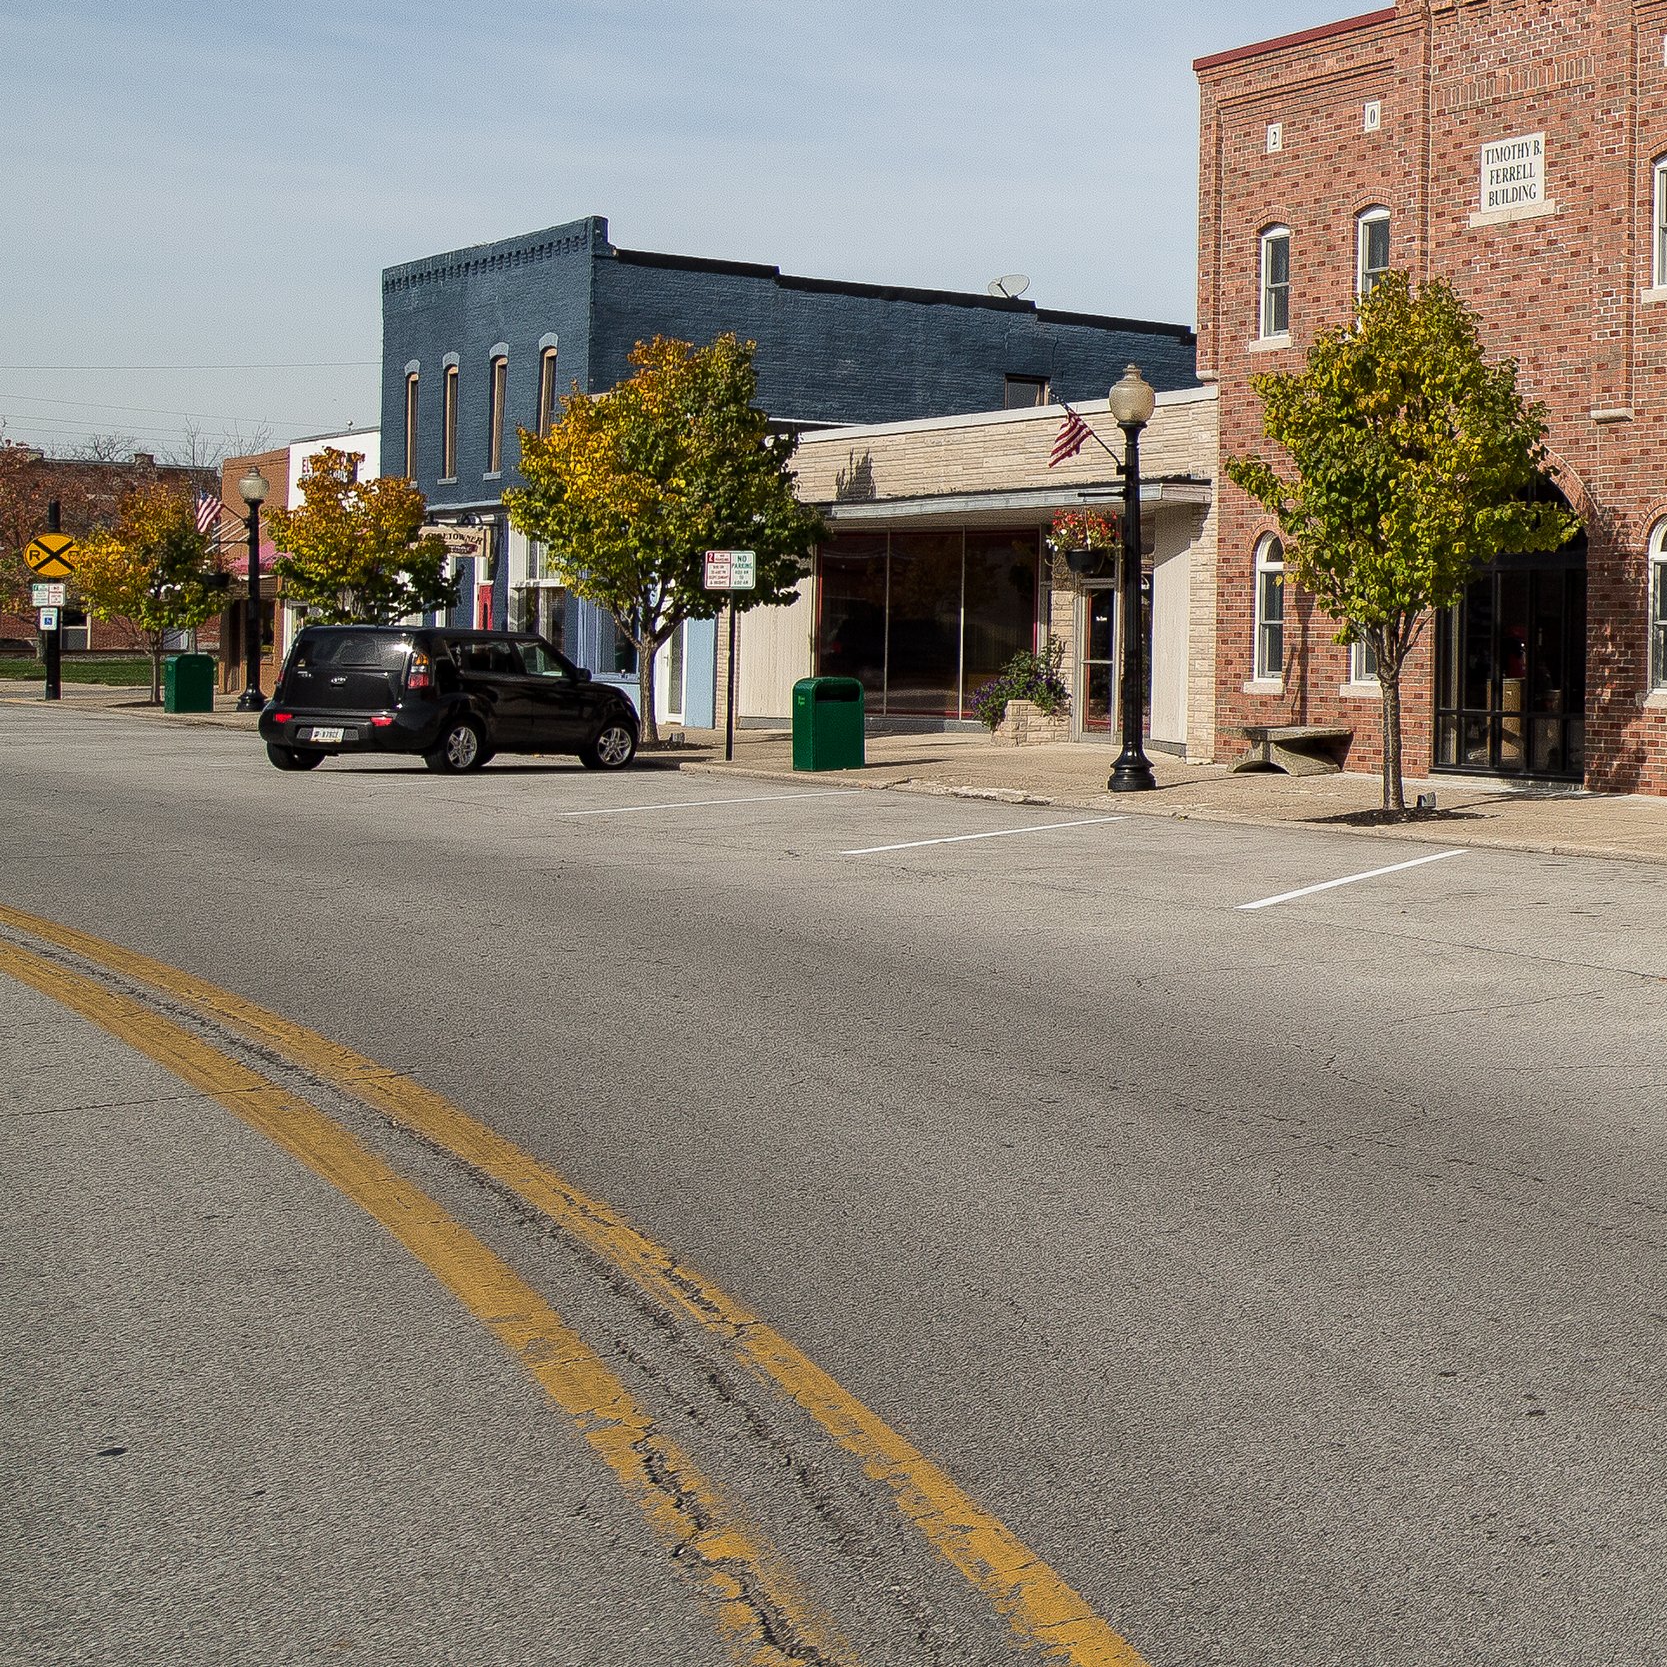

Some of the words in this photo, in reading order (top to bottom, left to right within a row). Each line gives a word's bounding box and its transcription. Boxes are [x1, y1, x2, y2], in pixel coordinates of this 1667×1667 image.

[1272, 131, 1278, 146] 2
[1370, 108, 1376, 124] 0
[1484, 140, 1532, 166] TIMOTHY
[1533, 139, 1542, 156] B.
[1489, 162, 1536, 186] FERRELL
[1488, 183, 1537, 207] BUILDING
[29, 549, 40, 561] R
[737, 555, 747, 563] NO
